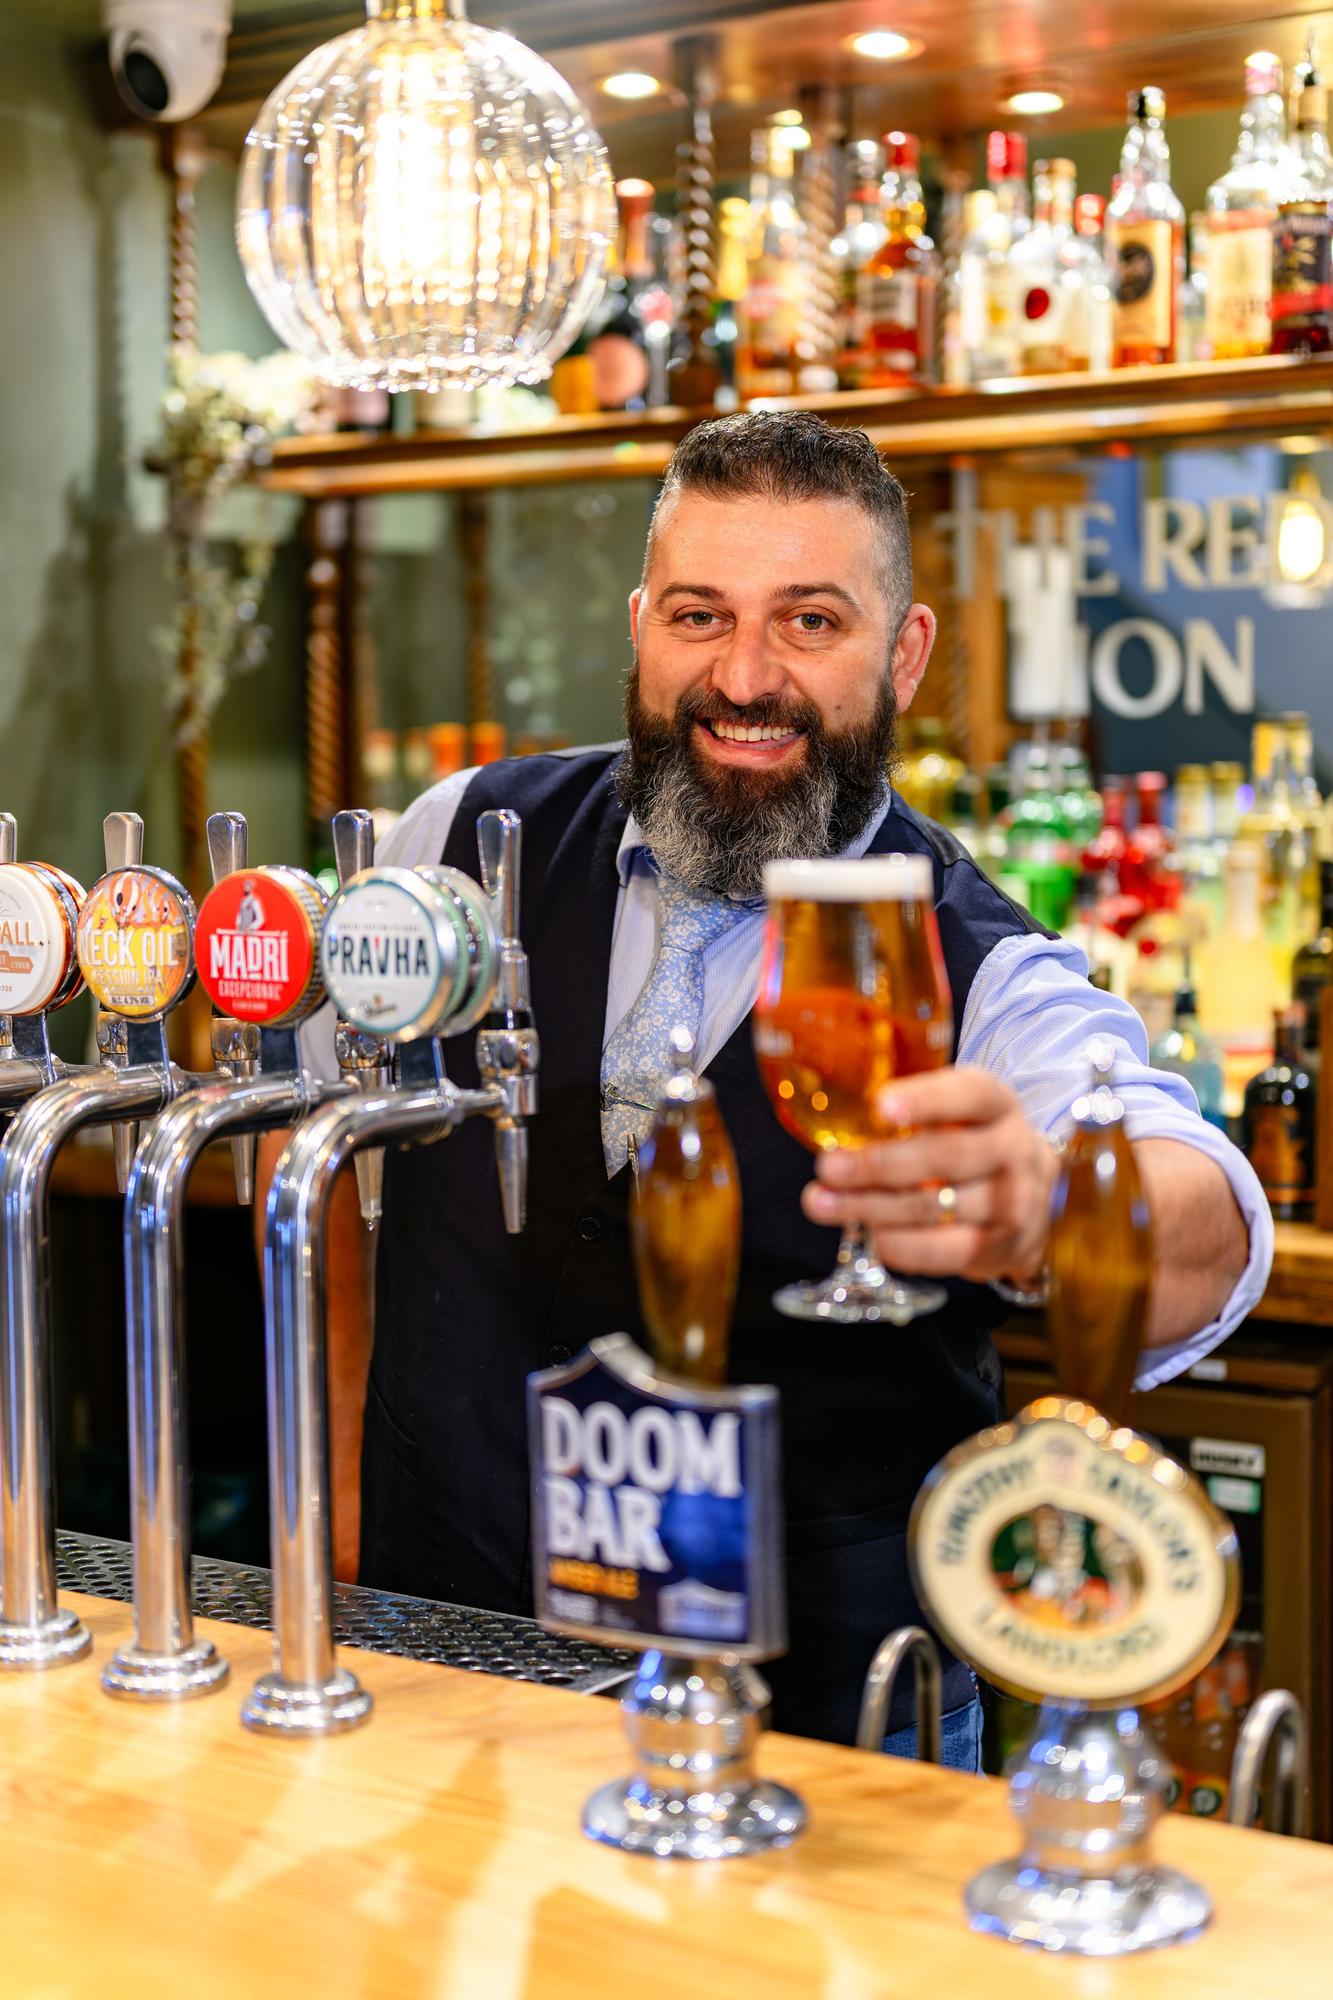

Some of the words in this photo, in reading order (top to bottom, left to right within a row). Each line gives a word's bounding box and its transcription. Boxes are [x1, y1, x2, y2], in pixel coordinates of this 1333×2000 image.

[1072, 617, 1256, 720] ON
[0, 920, 35, 946] ALL
[77, 928, 136, 967] NECK
[142, 930, 180, 967] OIL
[328, 935, 430, 976] PRAVHA
[540, 1397, 743, 1499] DOOM
[544, 1476, 672, 1573] BAR
